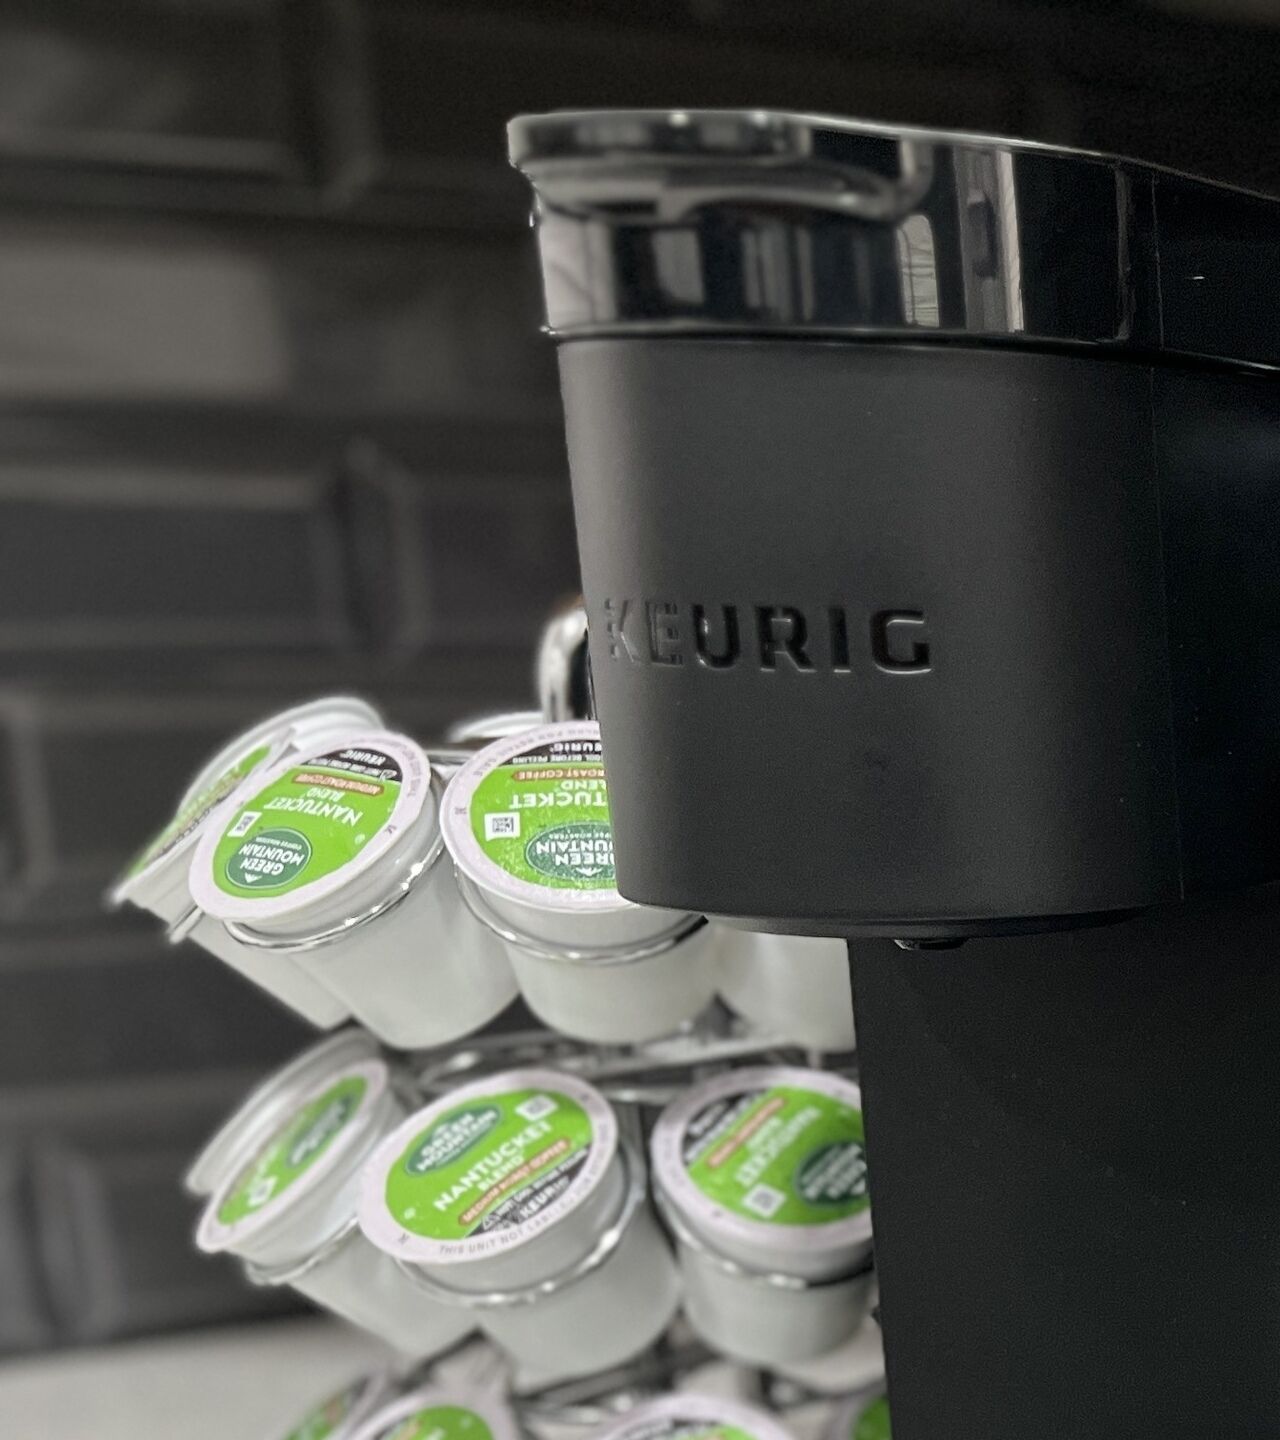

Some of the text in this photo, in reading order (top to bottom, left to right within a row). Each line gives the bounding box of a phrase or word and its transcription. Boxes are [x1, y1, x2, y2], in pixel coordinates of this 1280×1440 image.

[602, 599, 932, 674] KEURIG
[517, 768, 606, 780] ROAST COFFEE
[305, 786, 346, 800] BLEND
[560, 780, 607, 791] LEND
[510, 792, 608, 809] TUCKET
[263, 796, 364, 828] NANTUCKET
[238, 843, 306, 867] MOUNTAIN
[239, 857, 284, 876] GREEN
[421, 1111, 477, 1157] GREEN
[432, 1119, 553, 1212] NANTUCKET
